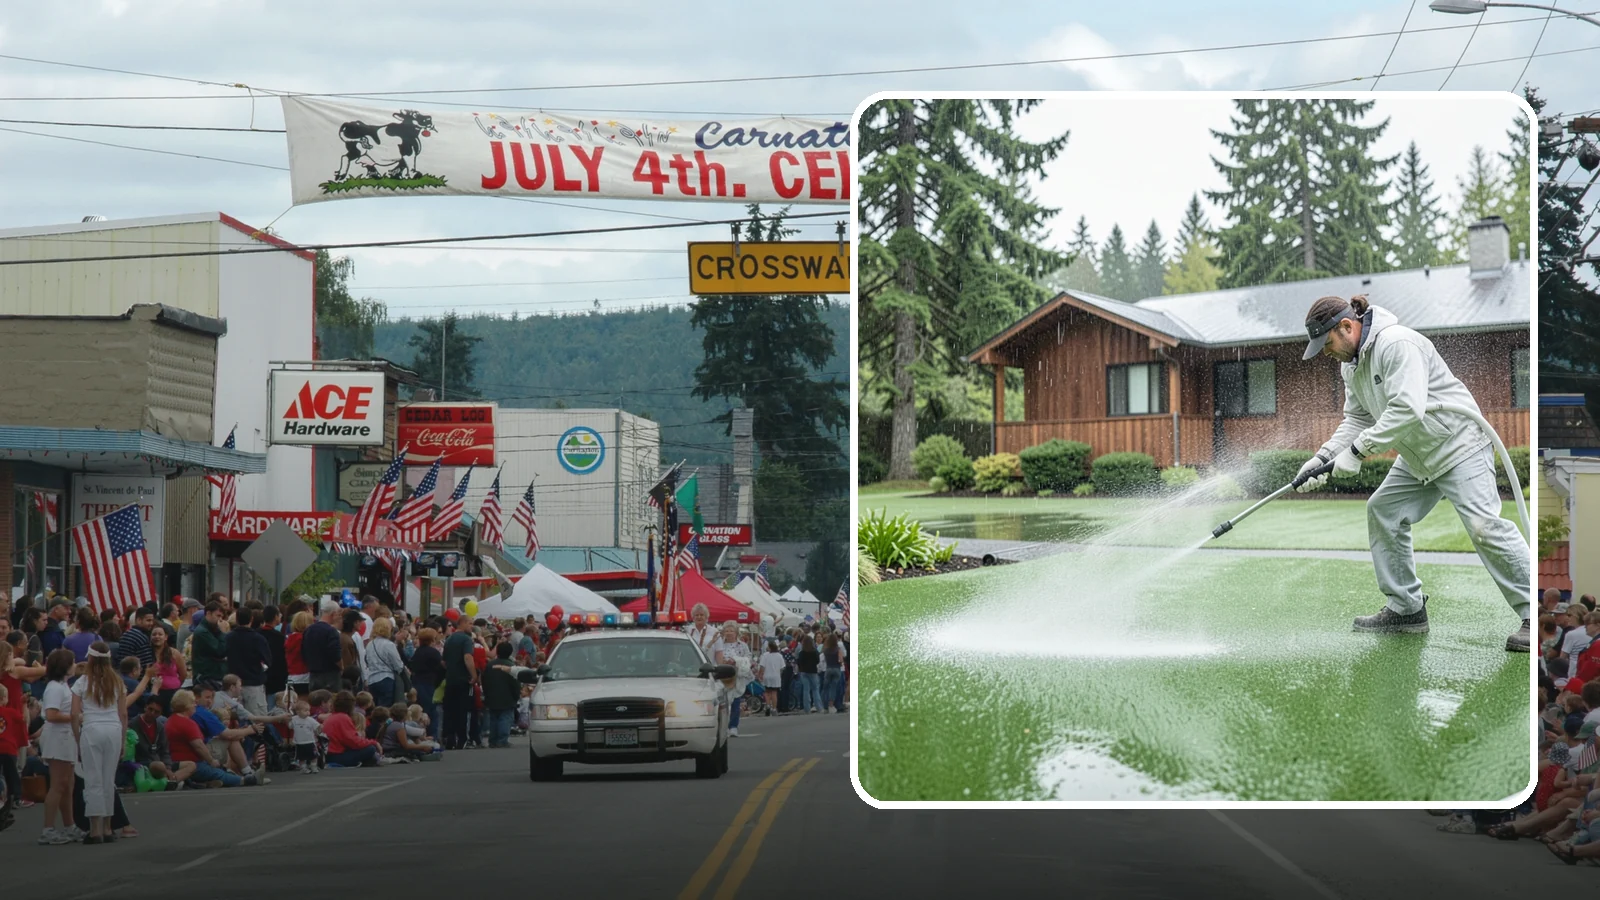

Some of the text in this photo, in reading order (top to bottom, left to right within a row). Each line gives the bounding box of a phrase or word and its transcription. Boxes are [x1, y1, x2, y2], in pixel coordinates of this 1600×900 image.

[482, 142, 604, 193] JULY
[633, 150, 747, 198] 4th.
[697, 254, 850, 280] CROSSWA
[282, 380, 373, 420] ACE
[405, 409, 485, 421] CEDAR LOG
[283, 421, 371, 436] Hardware
[416, 428, 477, 447] Coca-Cola
[353, 467, 384, 479] Simpl
[83, 485, 155, 495] St. Vincent de Paul
[688, 526, 741, 535] CRNATION
[699, 535, 730, 543] GLASS
